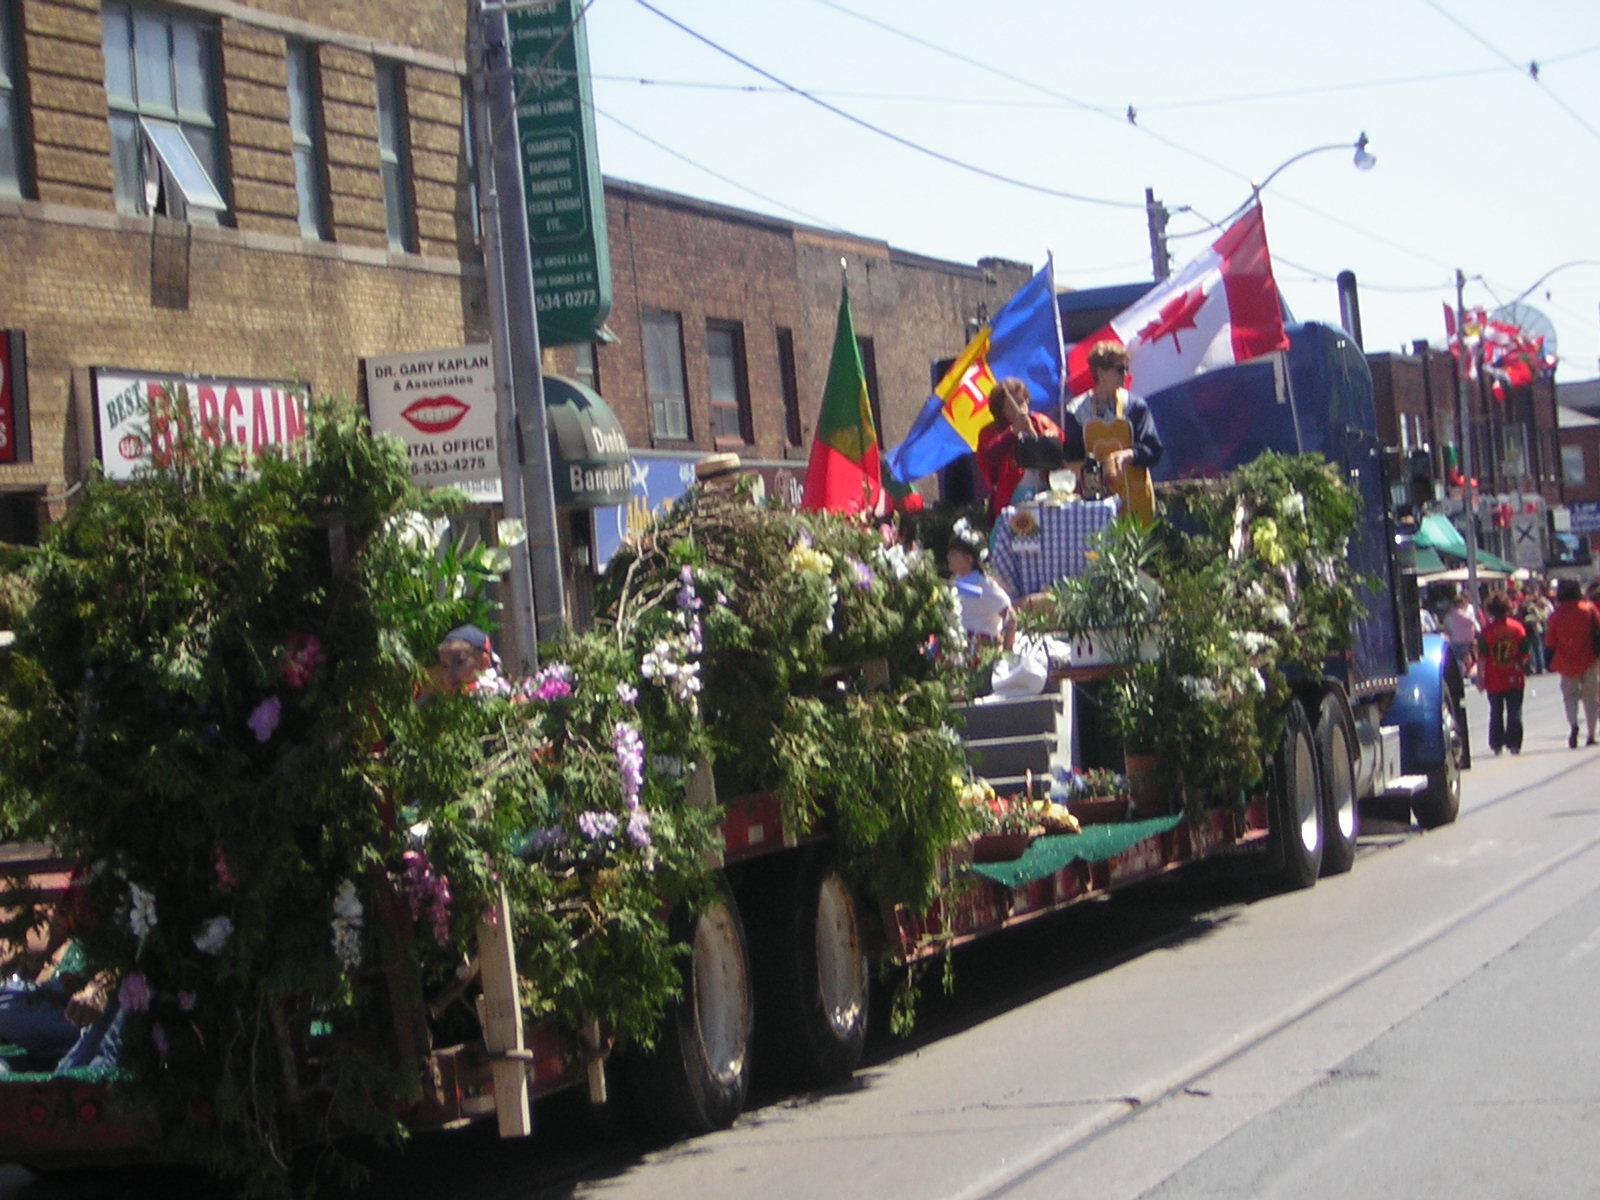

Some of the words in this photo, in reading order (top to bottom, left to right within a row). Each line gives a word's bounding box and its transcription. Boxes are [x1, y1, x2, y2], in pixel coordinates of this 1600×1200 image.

[374, 366, 397, 379] DR.
[400, 361, 434, 376] GARY
[438, 355, 489, 372] KAPLAN
[393, 380, 402, 392] &
[405, 374, 474, 391] Associates
[106, 378, 142, 431] BEST
[406, 443, 438, 459] NTAL
[442, 437, 495, 454] OFFICE
[408, 457, 486, 476] 6-533-4275
[569, 464, 624, 496] Banquet
